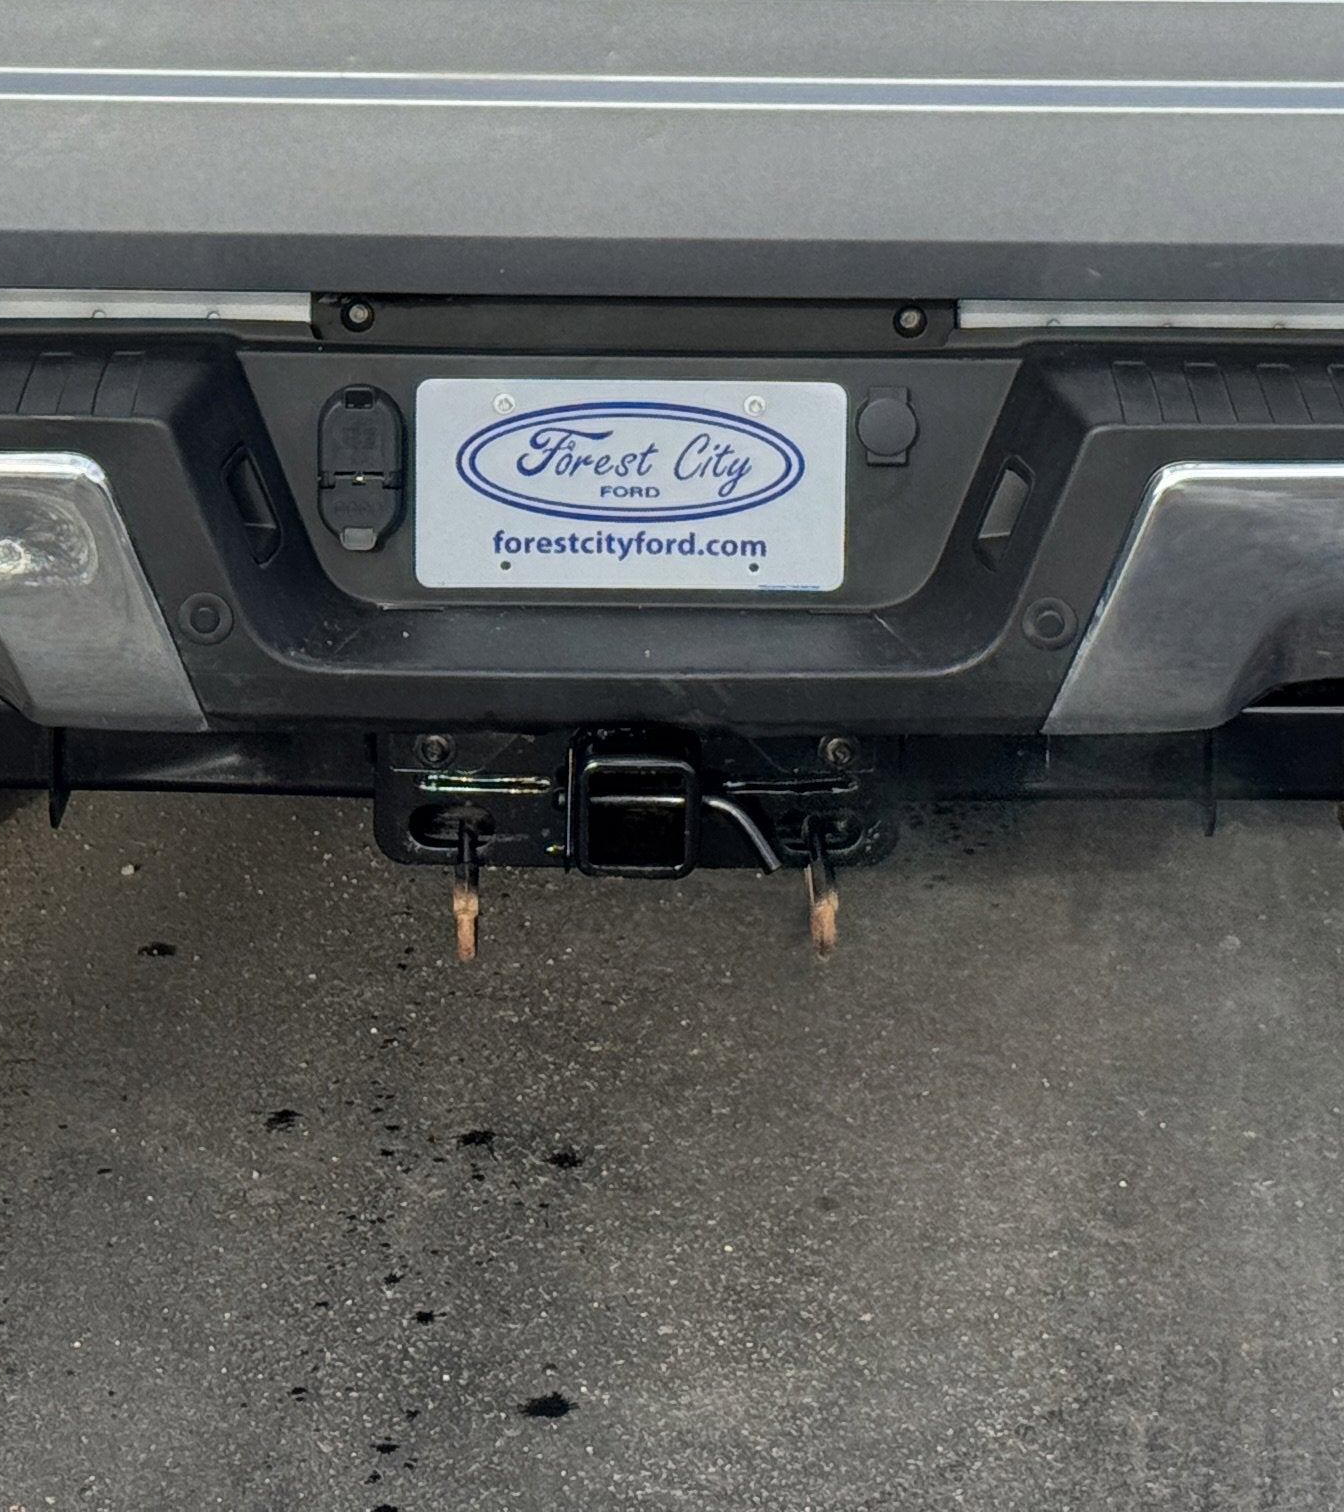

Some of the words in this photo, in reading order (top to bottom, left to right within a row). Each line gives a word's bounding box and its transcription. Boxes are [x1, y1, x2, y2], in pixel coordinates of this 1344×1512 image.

[516, 427, 659, 477] Forest
[673, 433, 752, 498] City
[599, 485, 661, 499] FORD
[493, 530, 768, 561] forestcityford.com
